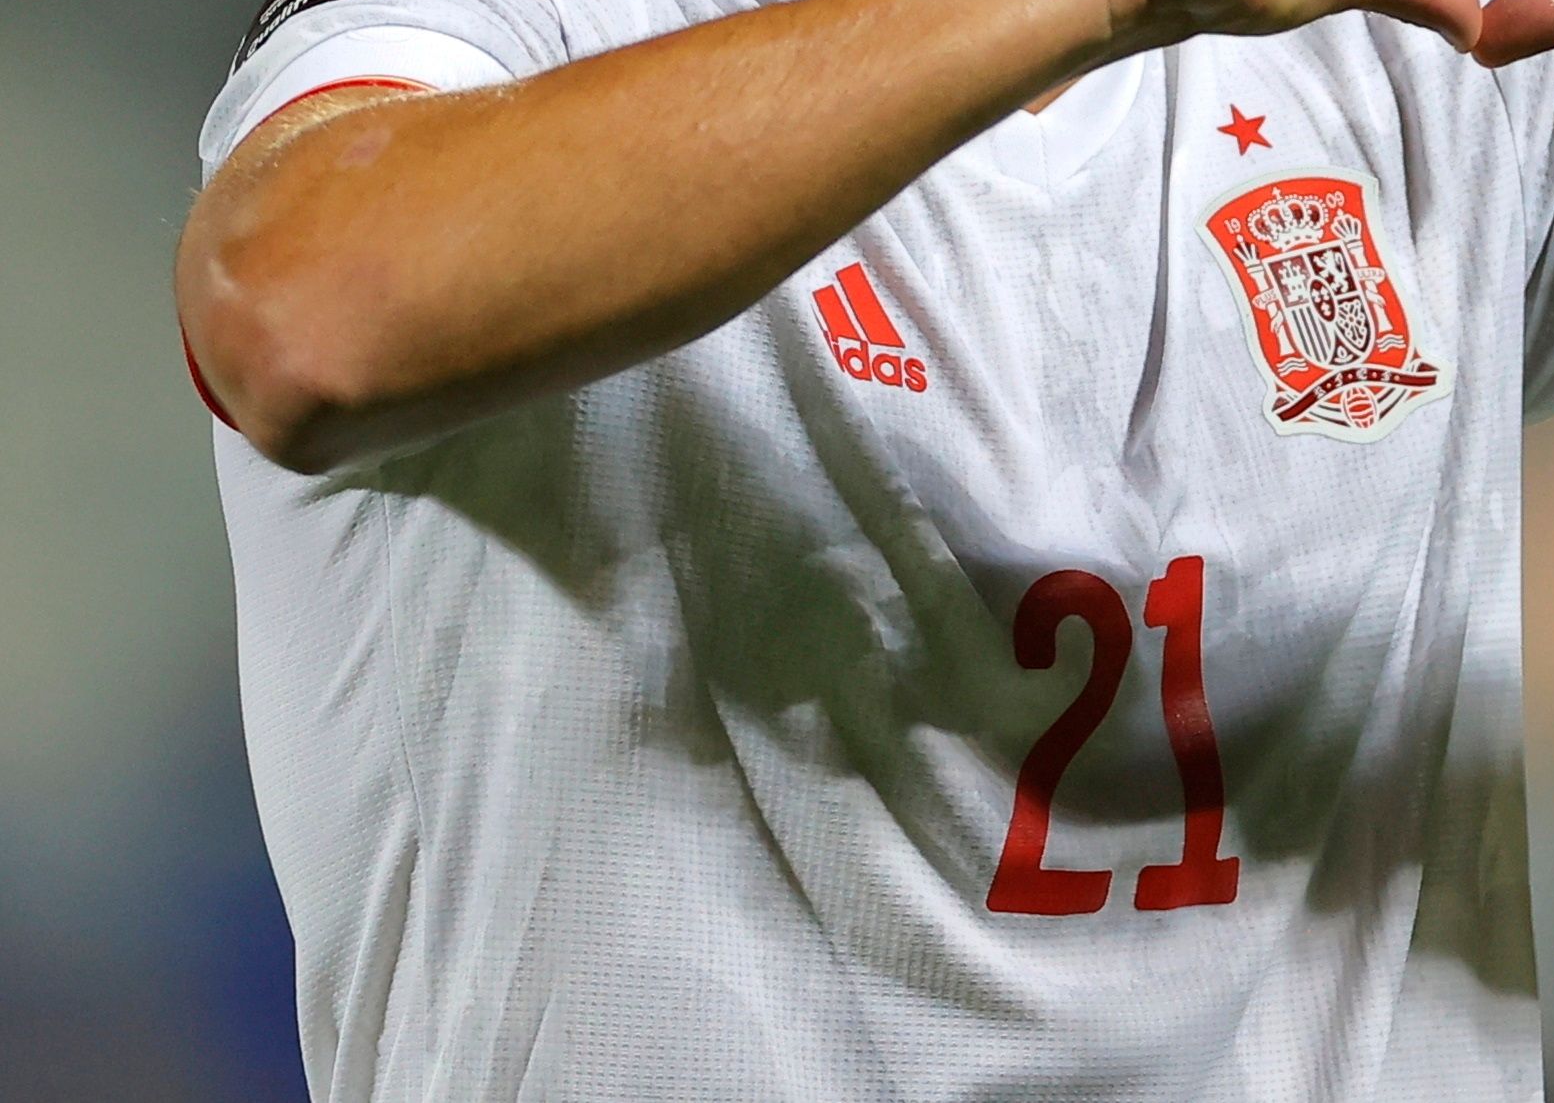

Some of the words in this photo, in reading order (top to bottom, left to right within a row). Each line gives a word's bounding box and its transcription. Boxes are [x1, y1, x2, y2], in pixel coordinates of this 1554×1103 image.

[1325, 191, 1344, 208] 09
[1224, 218, 1241, 233] 19
[986, 555, 1240, 915] 21
